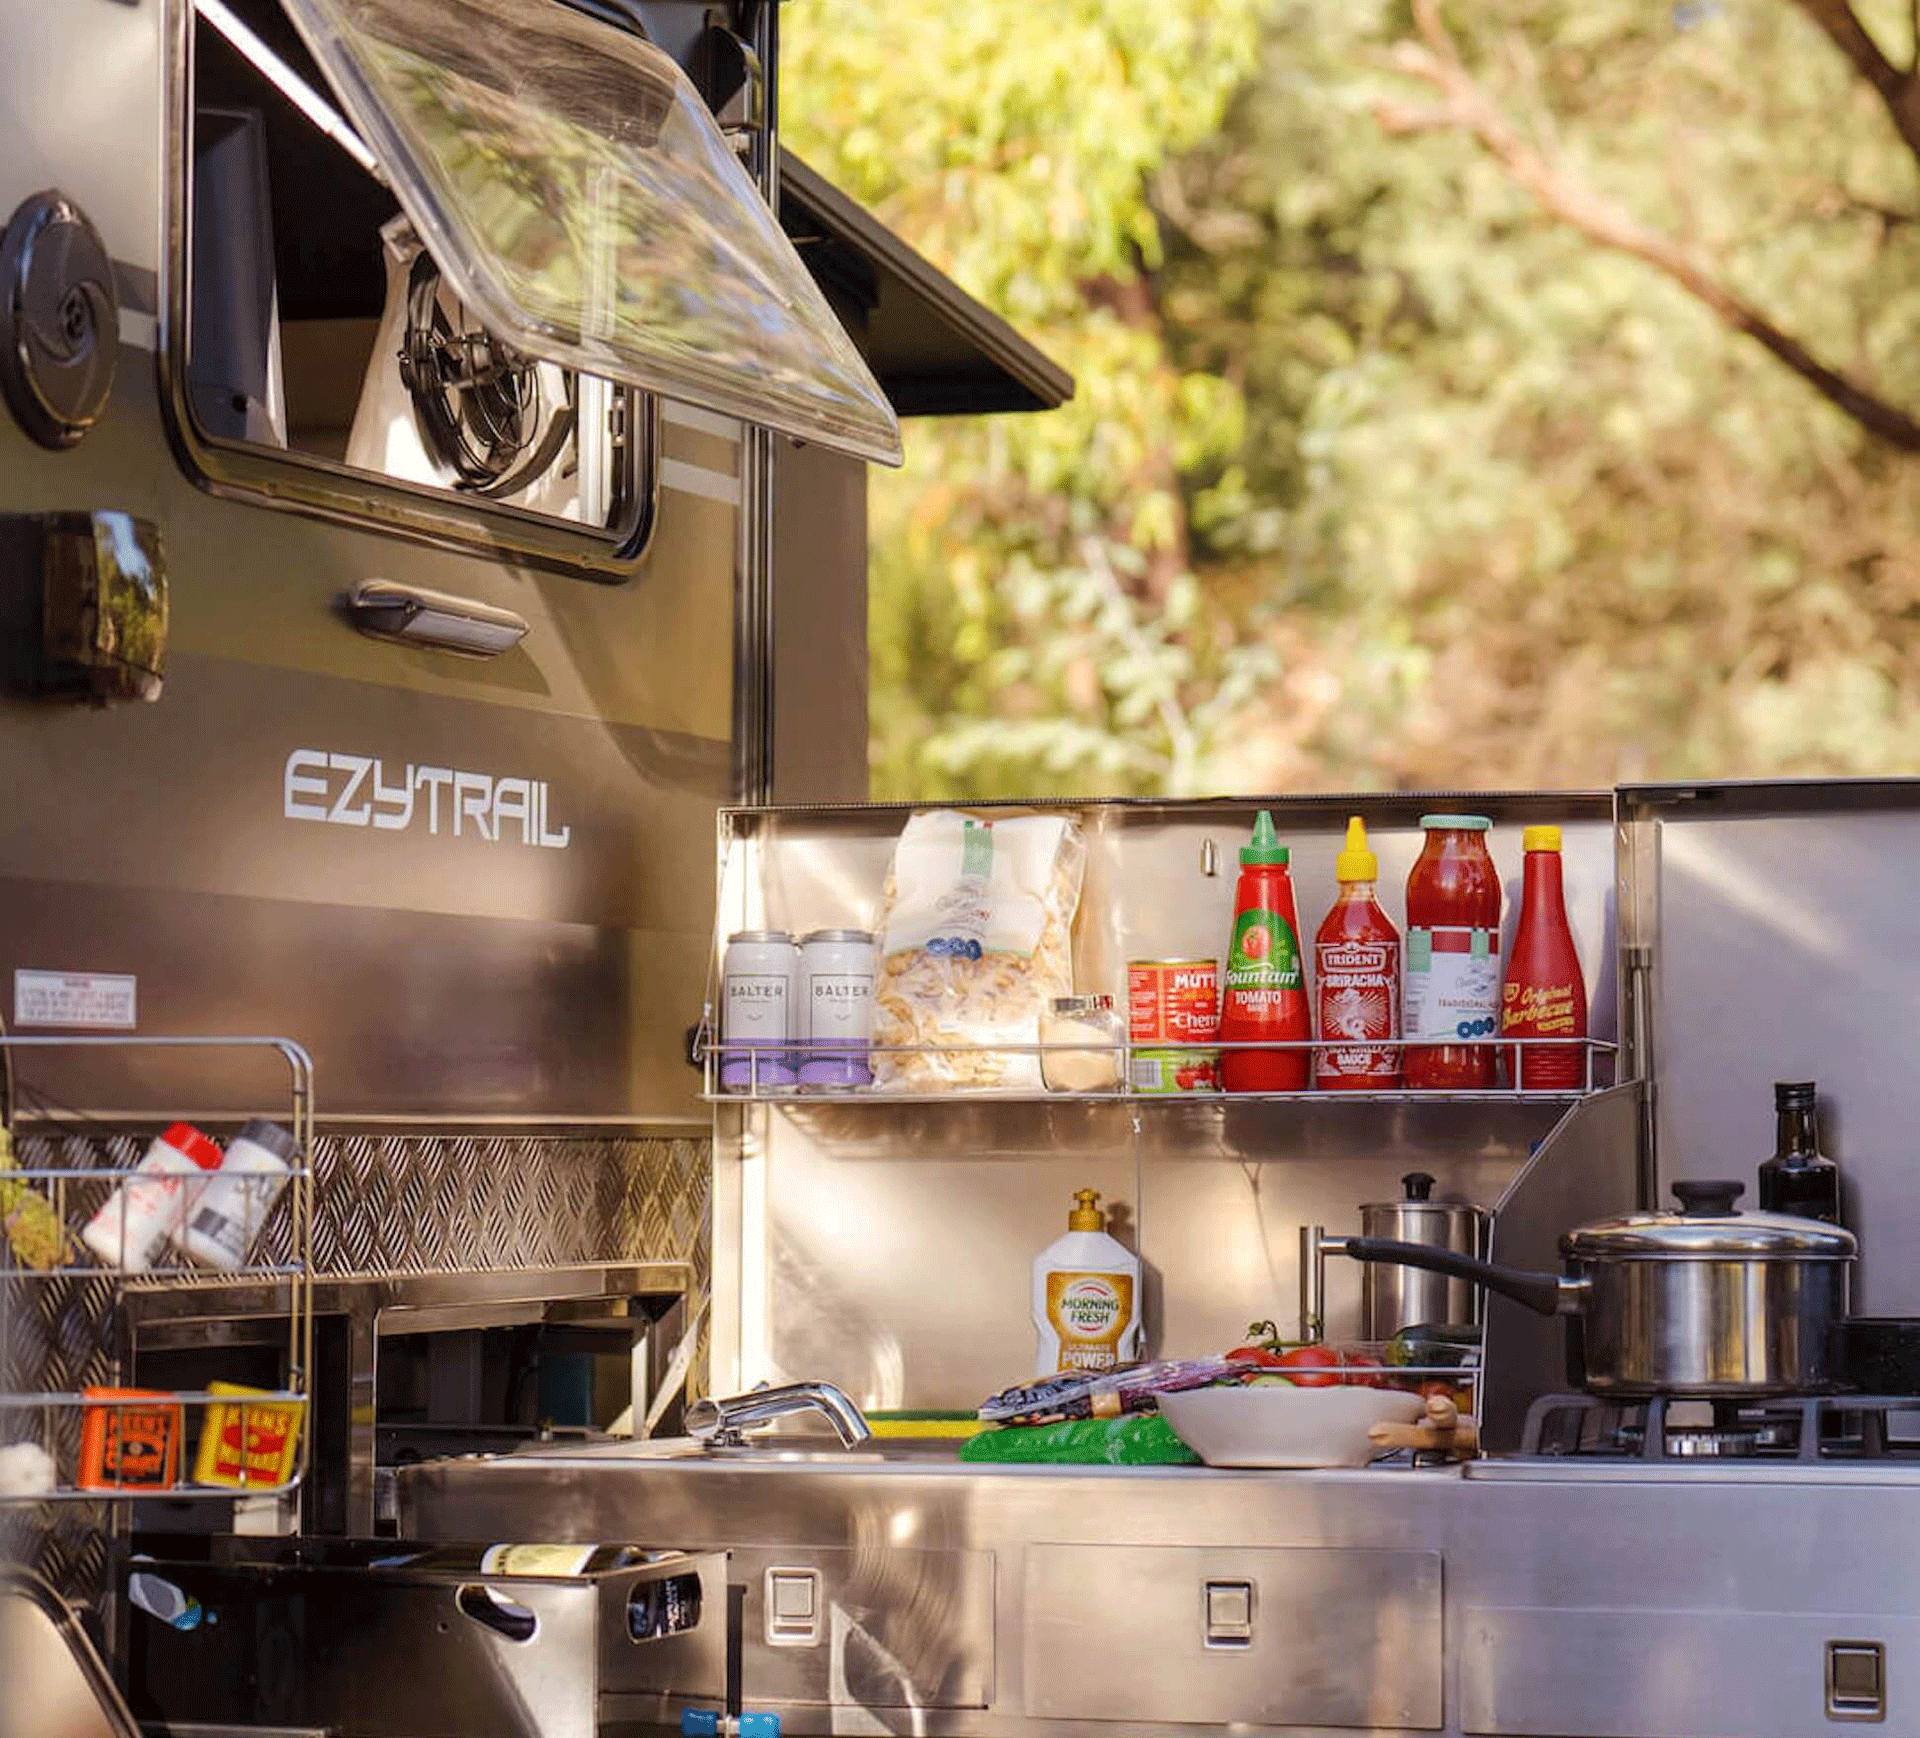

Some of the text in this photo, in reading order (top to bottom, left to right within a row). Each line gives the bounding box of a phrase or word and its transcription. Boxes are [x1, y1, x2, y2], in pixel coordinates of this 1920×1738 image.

[284, 748, 570, 849] EZYTRAIL
[1327, 953, 1379, 966] TRIDENT
[1325, 973, 1385, 988] SRIRACHA
[814, 984, 870, 998] BALTER
[1235, 990, 1282, 1006] TOMATO
[1061, 1297, 1119, 1311] MORNING
[1070, 1309, 1111, 1323] FRESH
[1062, 1352, 1115, 1369] POWER
[225, 1407, 289, 1437] KENS
